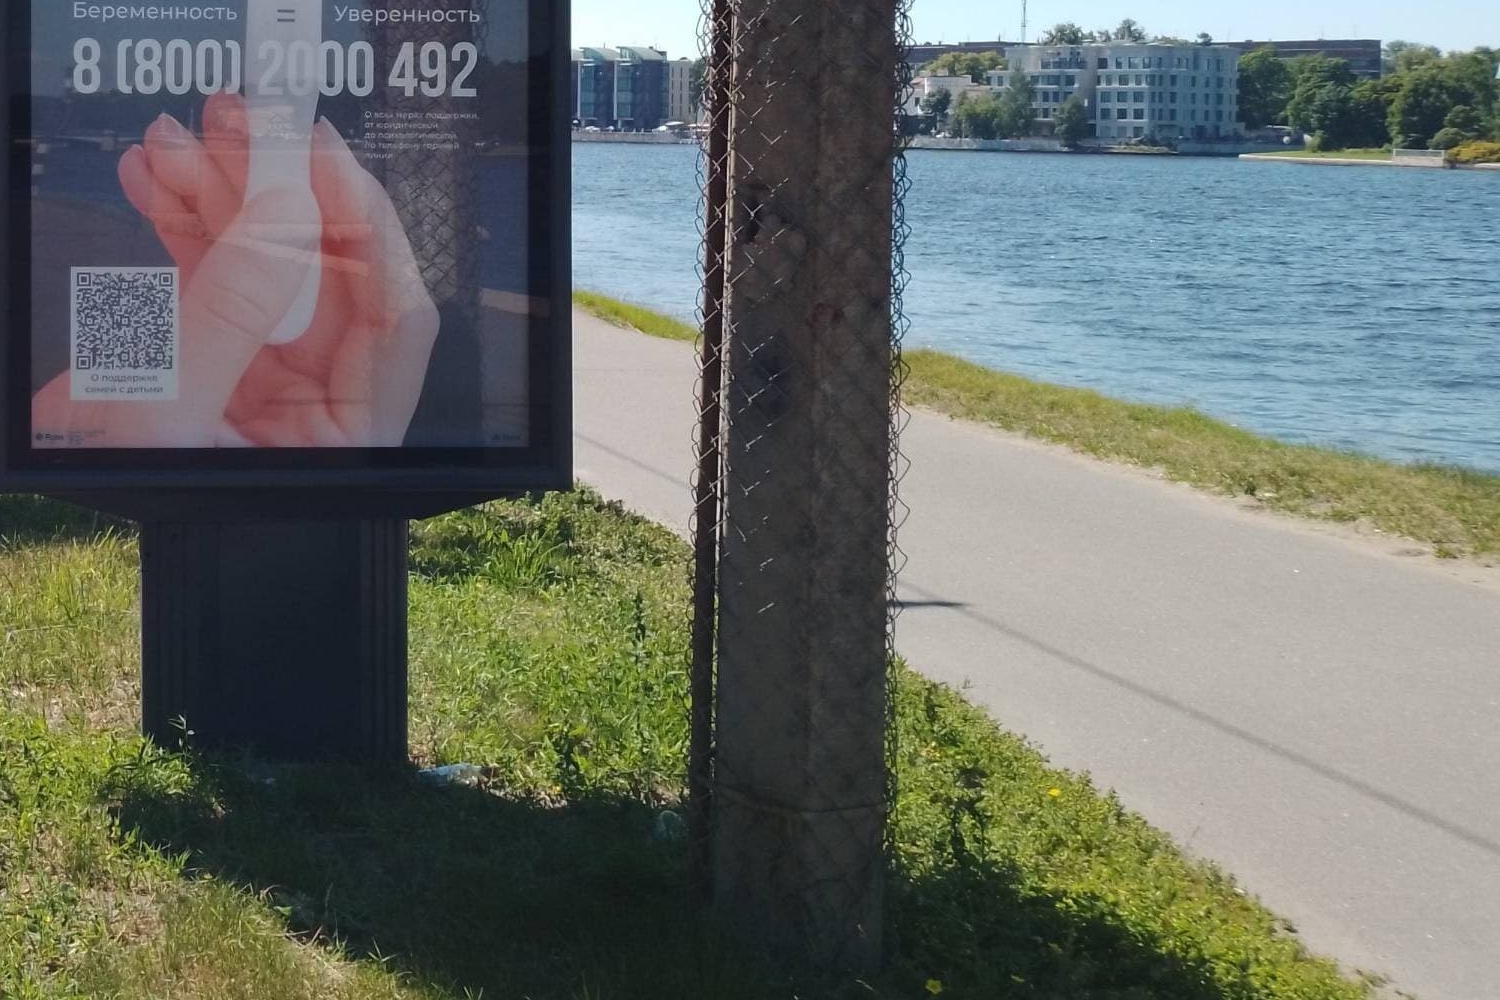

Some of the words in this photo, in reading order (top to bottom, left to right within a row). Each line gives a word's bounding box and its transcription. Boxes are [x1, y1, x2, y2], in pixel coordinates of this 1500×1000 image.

[73, 2, 238, 23] Беременность
[333, 5, 481, 26] Уверенность
[73, 37, 101, 95] 8
[116, 38, 241, 96] (800)
[257, 40, 375, 97] 2000
[388, 41, 478, 98] 492
[90, 374, 100, 382] О
